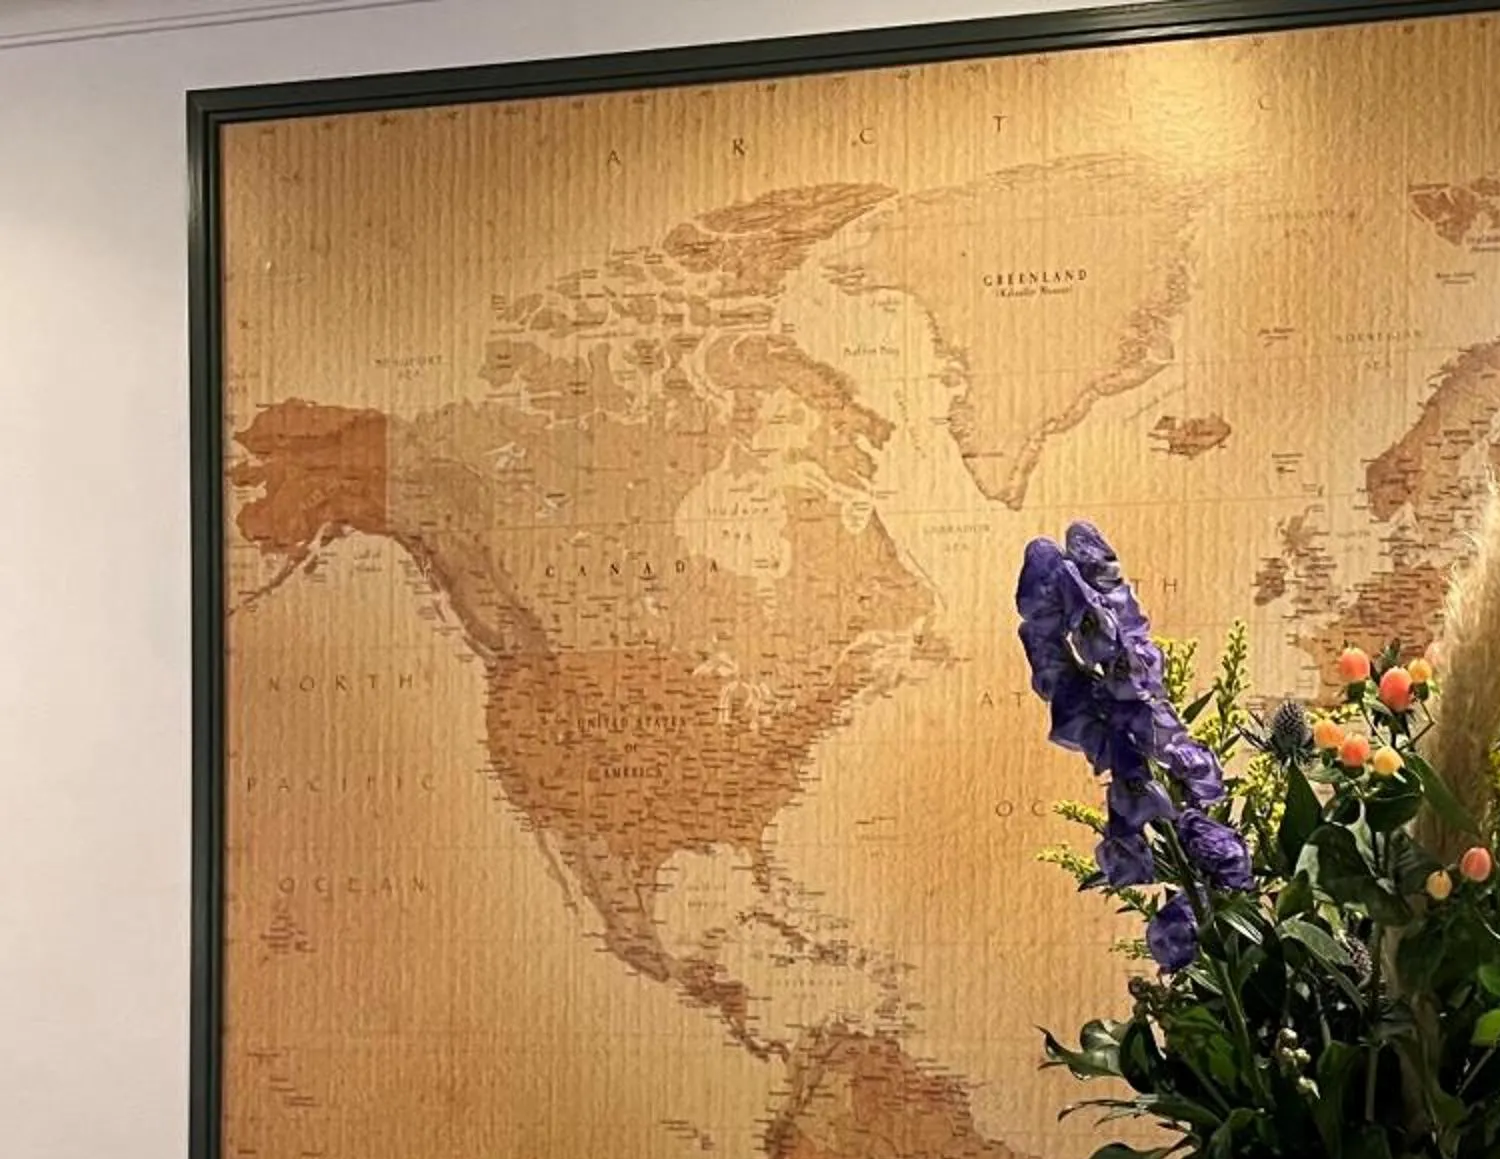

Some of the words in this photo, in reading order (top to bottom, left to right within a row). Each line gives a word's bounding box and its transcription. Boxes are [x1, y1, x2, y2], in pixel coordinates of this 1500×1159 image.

[983, 267, 1088, 287] GREENLAND
[544, 558, 720, 579] CANADA
[268, 673, 414, 693] NORTH
[278, 876, 427, 896] OCEAN
